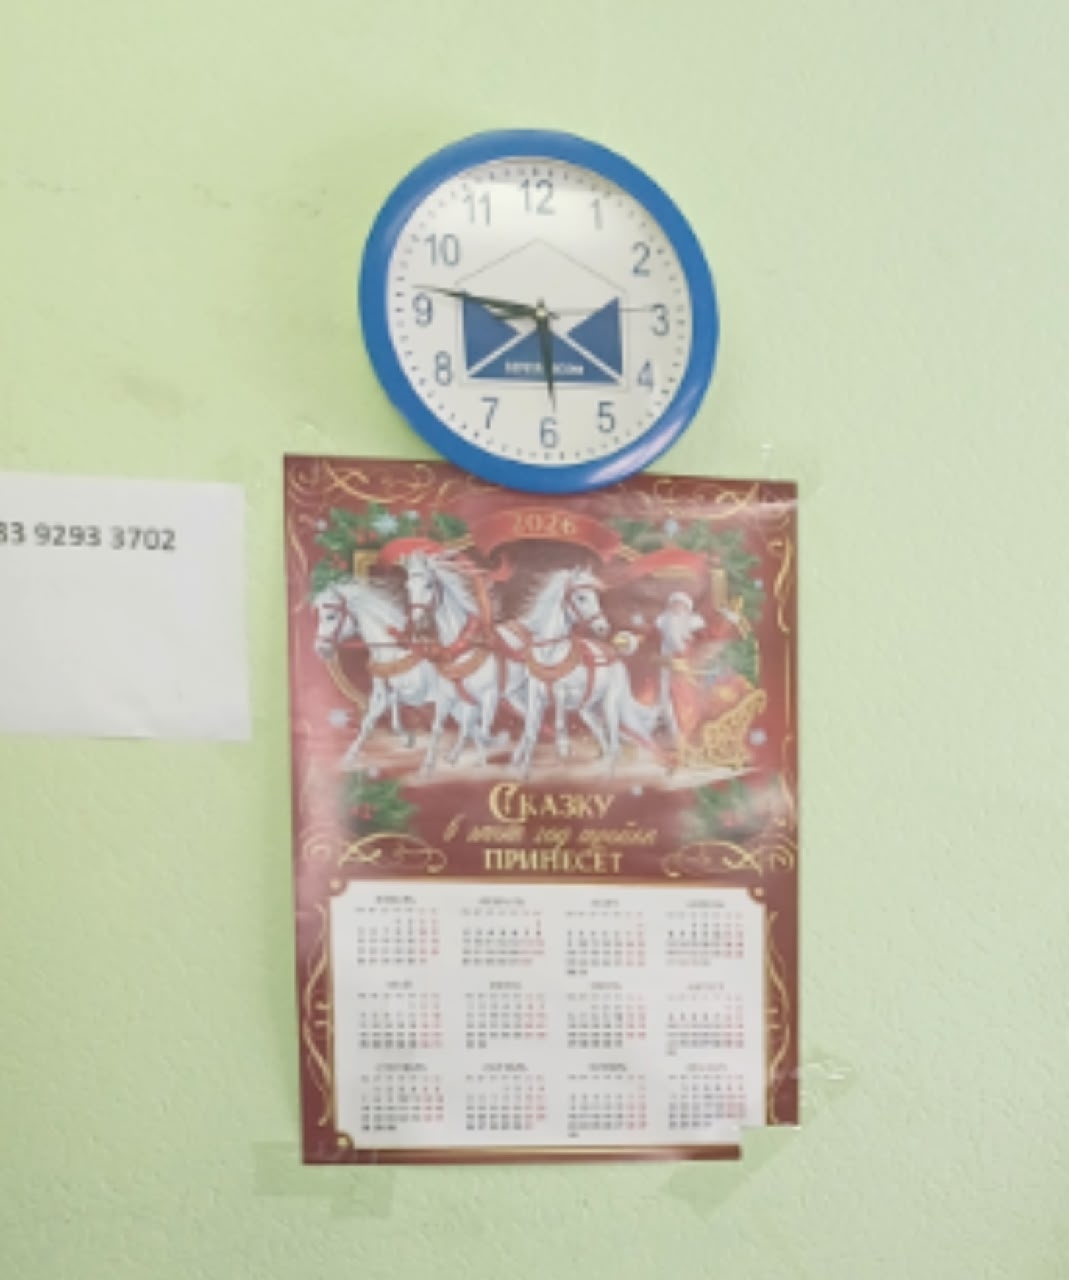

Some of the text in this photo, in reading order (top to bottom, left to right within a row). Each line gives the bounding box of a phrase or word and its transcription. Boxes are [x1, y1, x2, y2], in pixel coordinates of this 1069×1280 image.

[464, 193, 491, 226] 11
[521, 179, 555, 215] 12
[591, 199, 603, 230] 1
[426, 233, 461, 266] 10
[631, 242, 652, 276] 2
[412, 293, 433, 327] 9
[652, 303, 670, 336] 3
[434, 351, 452, 386] 8
[636, 361, 654, 393] 4
[481, 397, 499, 430] 7
[597, 402, 615, 434] 5
[540, 416, 558, 449] 6
[34, 522, 101, 546] 9293
[110, 525, 176, 551] 3702
[511, 510, 578, 537] 2026
